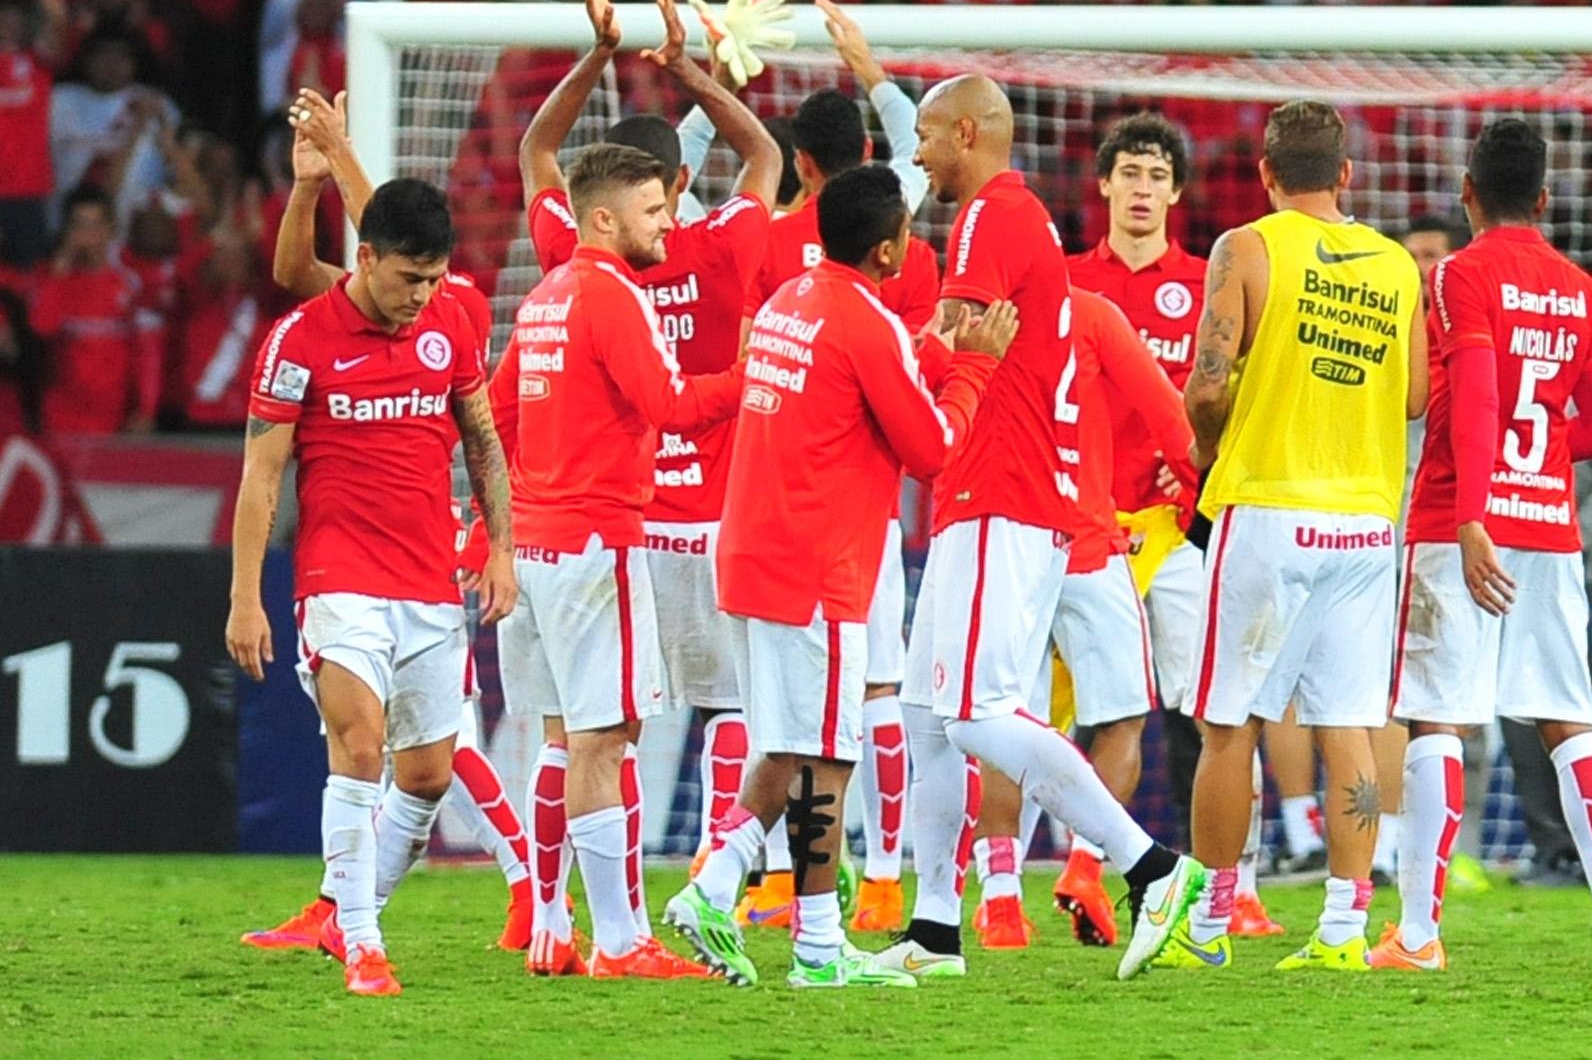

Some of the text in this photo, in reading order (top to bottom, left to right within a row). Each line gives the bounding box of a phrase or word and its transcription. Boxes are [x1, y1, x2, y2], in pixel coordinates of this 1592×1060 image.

[1303, 268, 1399, 316] Banrisul
[1297, 298, 1397, 340] TRAMONTINA
[1298, 322, 1388, 366] Unimed
[1503, 358, 1561, 474] 5
[1296, 523, 1393, 551] Unimed
[3, 640, 191, 769] 15
